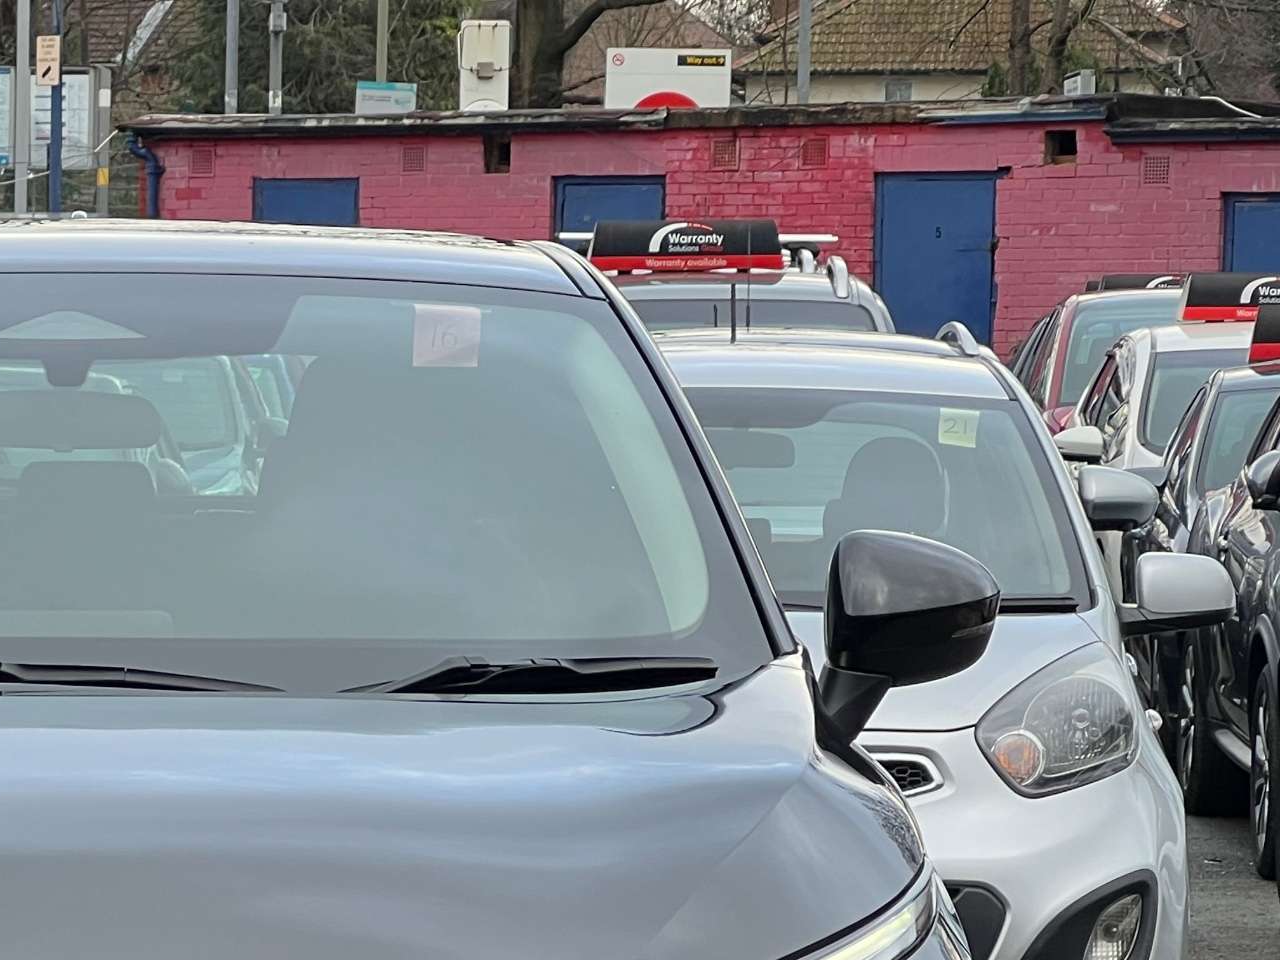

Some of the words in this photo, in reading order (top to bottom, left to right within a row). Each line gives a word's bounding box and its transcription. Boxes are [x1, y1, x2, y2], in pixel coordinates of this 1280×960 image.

[935, 226, 942, 239] 5
[668, 233, 724, 246] Warranty
[668, 244, 700, 252] Solutions
[645, 258, 686, 269] Warranty
[686, 258, 728, 268] available
[943, 417, 968, 435] 21
